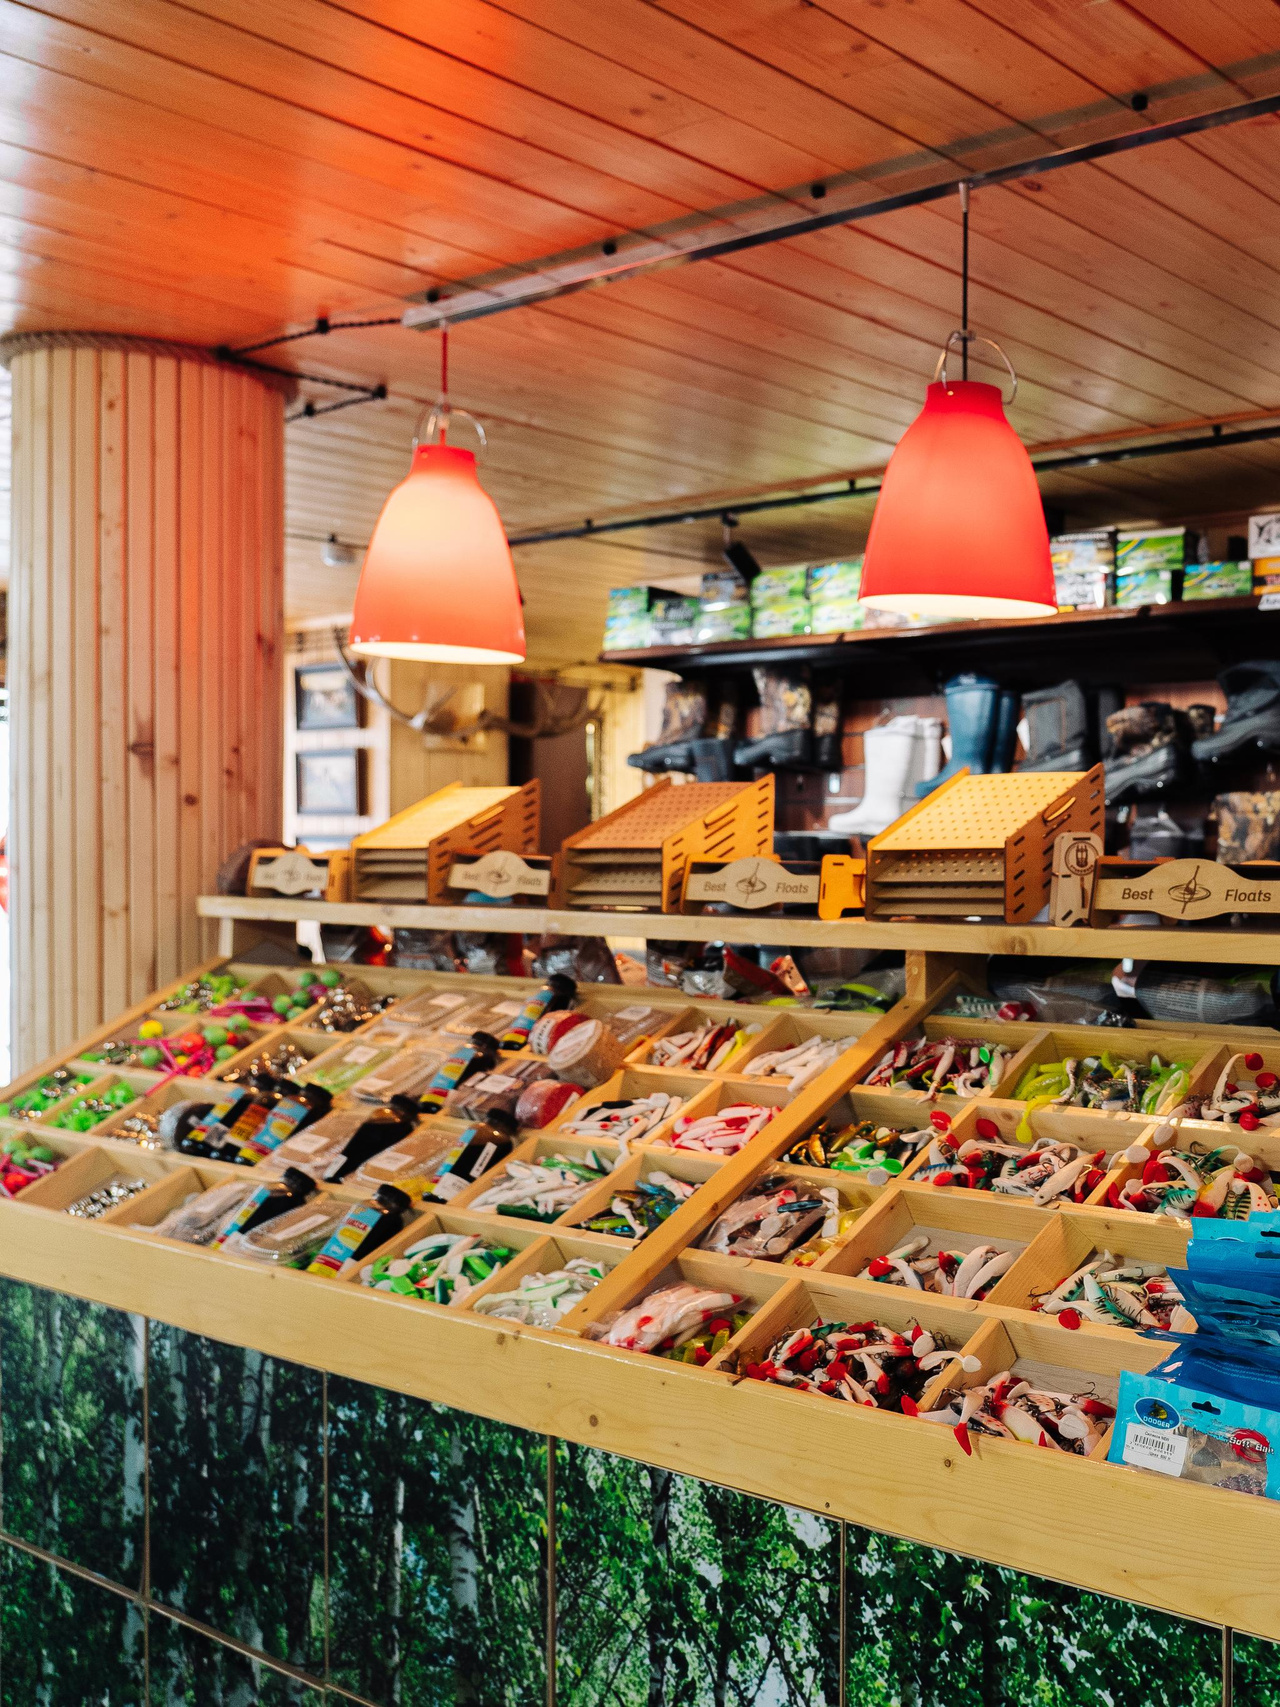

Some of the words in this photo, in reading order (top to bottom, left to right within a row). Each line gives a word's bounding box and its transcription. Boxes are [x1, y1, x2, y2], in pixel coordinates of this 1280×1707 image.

[703, 881, 727, 892] Best
[775, 882, 809, 893] Floats
[1121, 887, 1154, 900] Best
[1224, 888, 1272, 902] Floats
[1143, 1415, 1171, 1429] DODGER
[1229, 1436, 1250, 1449] Soft
[1255, 1443, 1275, 1456] Bait
